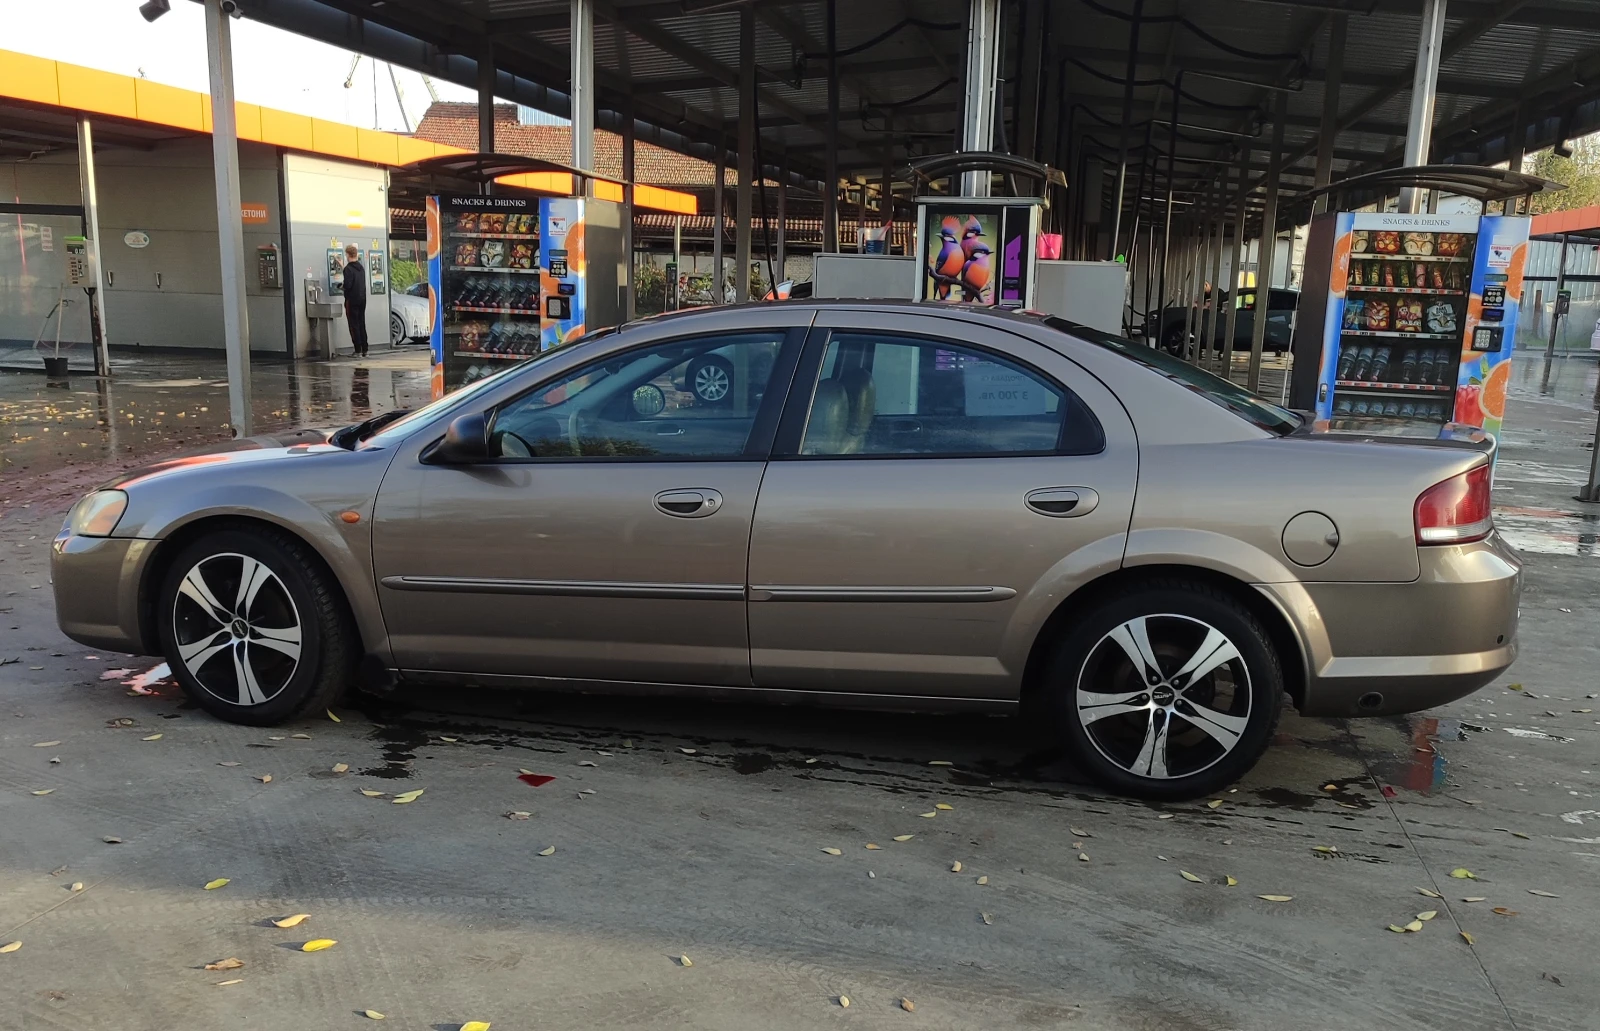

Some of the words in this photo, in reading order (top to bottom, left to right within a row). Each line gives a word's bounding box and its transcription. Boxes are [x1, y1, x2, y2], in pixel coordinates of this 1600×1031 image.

[451, 197, 485, 206] SNACKS
[494, 199, 527, 207] DRINKS
[1382, 218, 1413, 226] SNACKS
[1421, 219, 1451, 227] DRINKS
